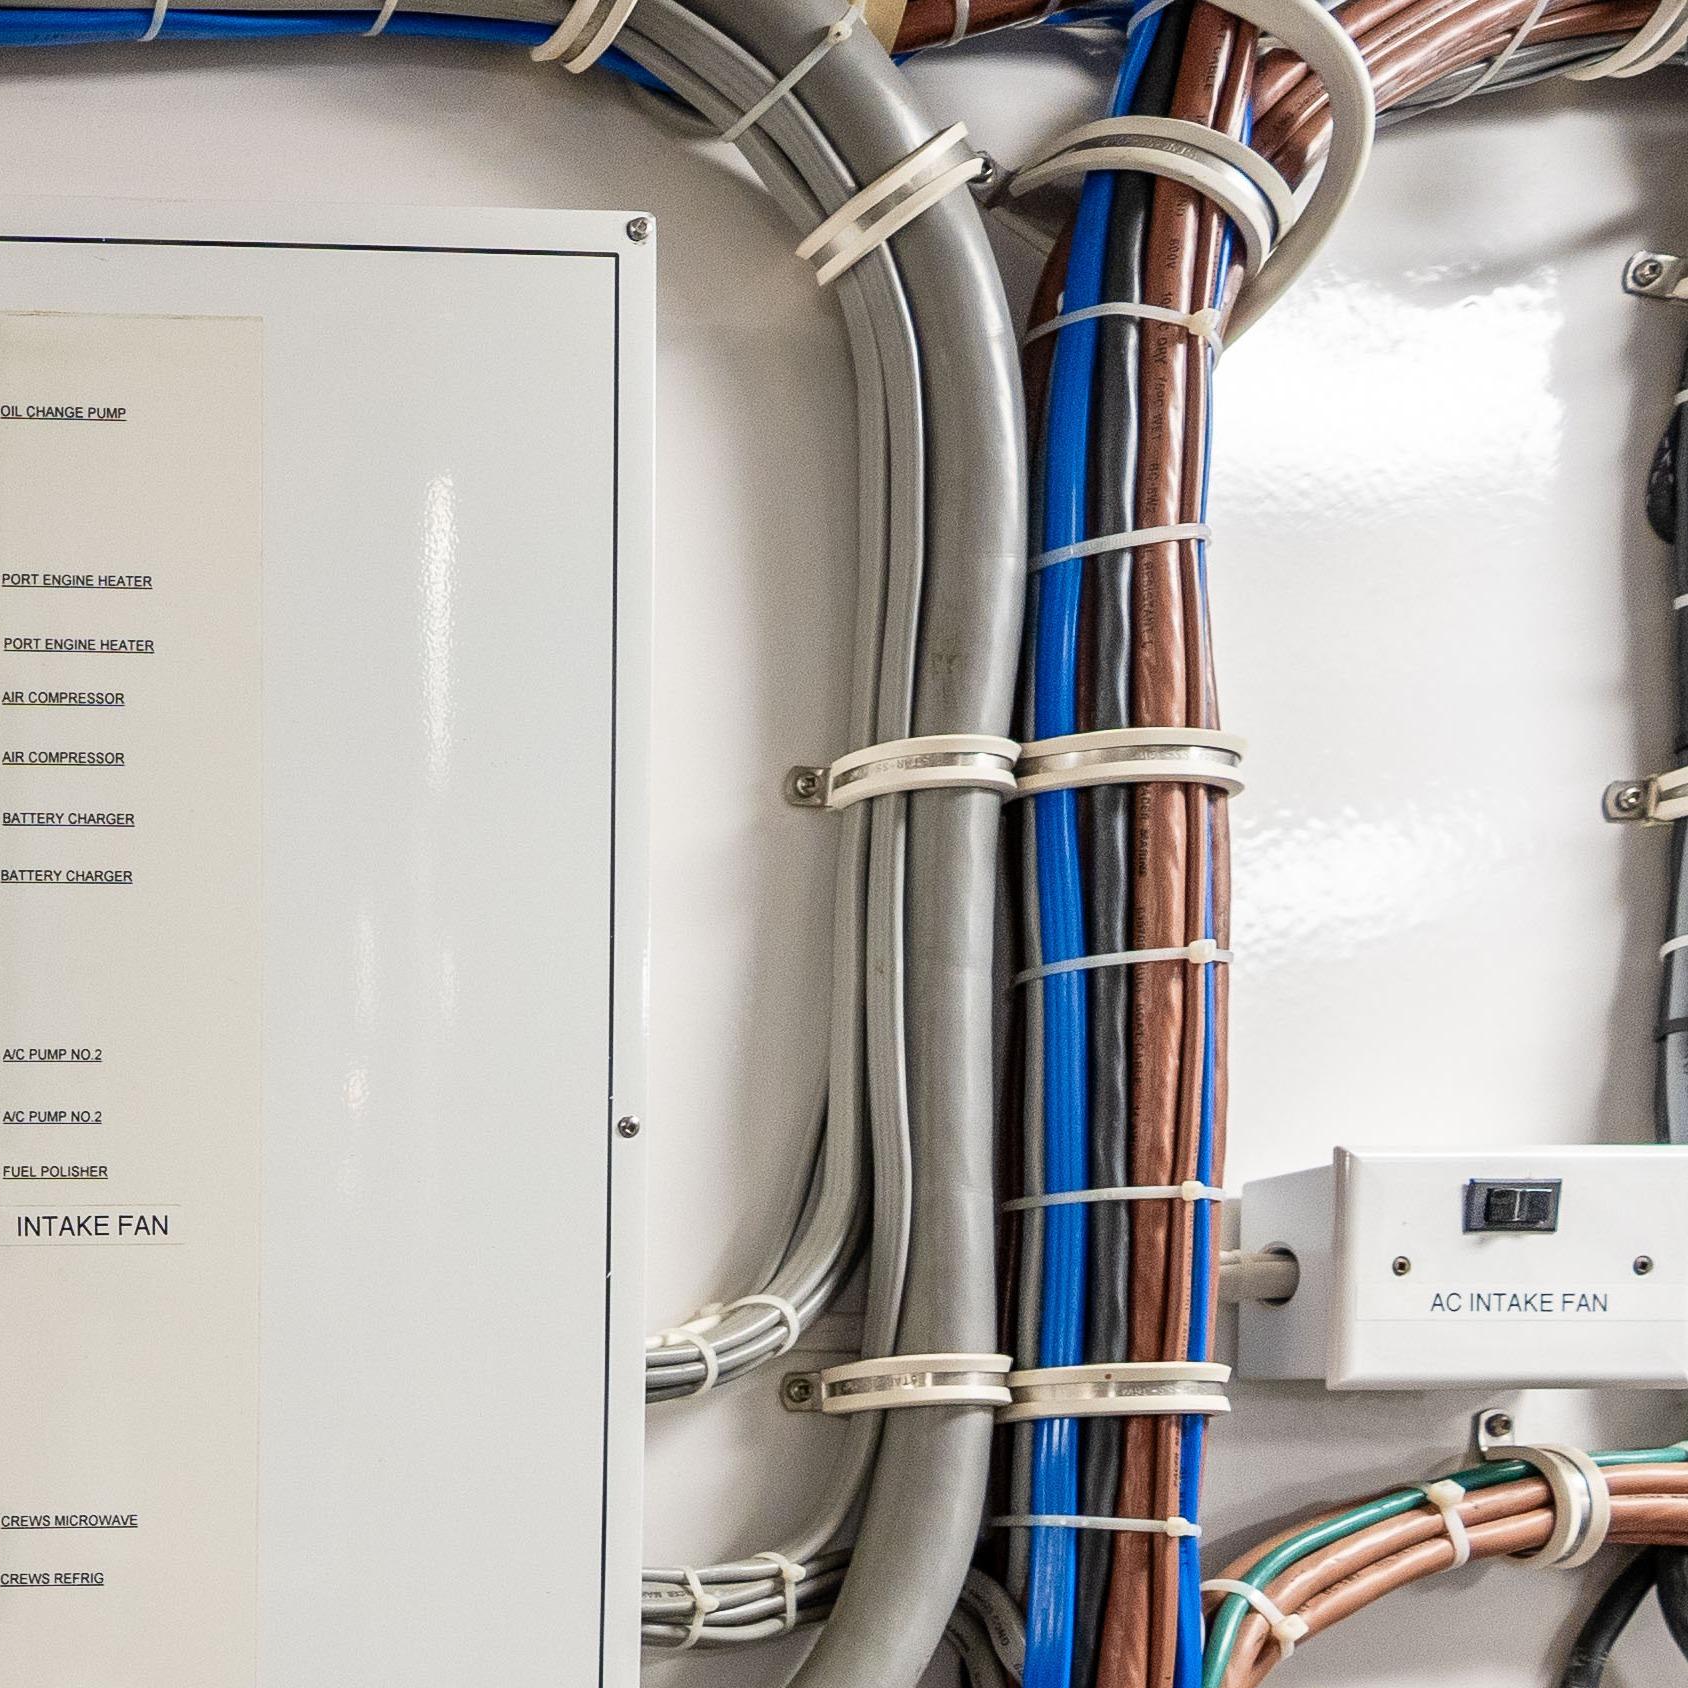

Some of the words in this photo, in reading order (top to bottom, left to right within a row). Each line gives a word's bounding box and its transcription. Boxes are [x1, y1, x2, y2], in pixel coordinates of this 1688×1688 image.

[0, 404, 23, 418] OIL
[25, 405, 84, 419] CHANGE
[87, 406, 127, 419] PUMP
[1, 573, 40, 587] PORT
[43, 573, 94, 588] ENGINE
[98, 575, 153, 587] HEATER
[1, 691, 25, 703] AIR
[28, 691, 125, 706] COMPRESSOR
[2, 812, 65, 825] BATTERY
[67, 812, 135, 825] CHARGER
[2, 1048, 25, 1062] A/C
[29, 1048, 67, 1061] PUMP
[71, 1048, 103, 1061] NO.2
[2, 1165, 35, 1179] FUEL
[40, 1165, 109, 1179] POLISHER
[17, 1215, 110, 1237] INTAKE
[118, 1215, 168, 1236] FAN
[1430, 1292, 1462, 1313] AC
[1469, 1292, 1554, 1313] INTAKE
[1561, 1292, 1609, 1313] FAN
[1, 1514, 51, 1528] CREWS
[54, 1514, 138, 1528] MICROWAVE
[0, 1572, 51, 1586] CREWS
[54, 1572, 105, 1586] REFRIG
